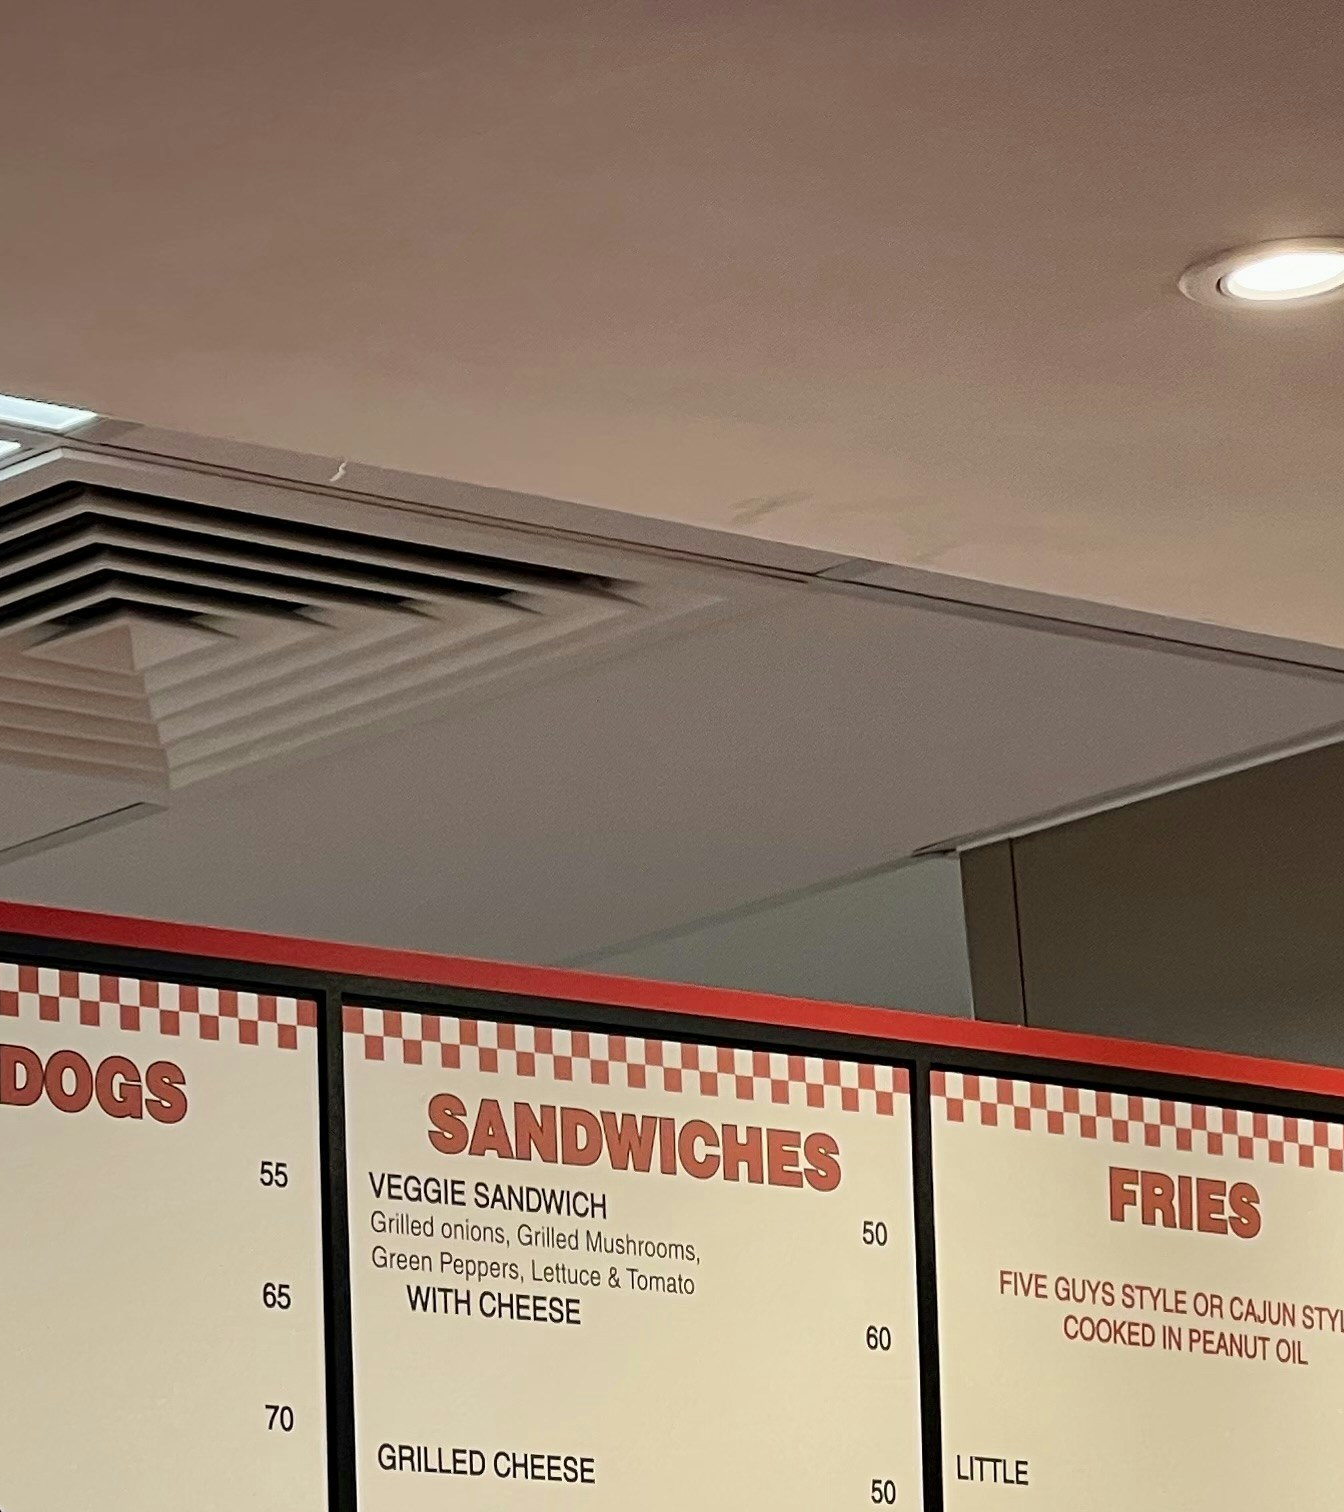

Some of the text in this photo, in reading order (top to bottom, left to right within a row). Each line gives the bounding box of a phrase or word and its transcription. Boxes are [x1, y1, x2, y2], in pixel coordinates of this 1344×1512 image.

[428, 1093, 841, 1192] SANDWICHES
[260, 1161, 288, 1187] 55
[369, 1172, 606, 1219] VEGGIE SANDWICH
[1109, 1166, 1261, 1238] FRIES
[371, 1211, 699, 1264] Grilled onions, Grilled Mushrooms,
[863, 1221, 887, 1246] 50
[372, 1246, 694, 1294] Green Peppers, Lettuce & Tomato
[263, 1283, 291, 1309] 65
[407, 1285, 581, 1324] WITH CHEESE
[1000, 1270, 1048, 1298] FIVE
[1055, 1277, 1114, 1306] GUYS
[1122, 1284, 1187, 1314] STYLE
[1193, 1292, 1223, 1319] OR
[1230, 1297, 1295, 1327] CAJUN
[867, 1325, 891, 1351] 60
[1064, 1315, 1308, 1365] COOKED IN PEANUT OIL
[957, 1455, 1028, 1485] LITTLE
